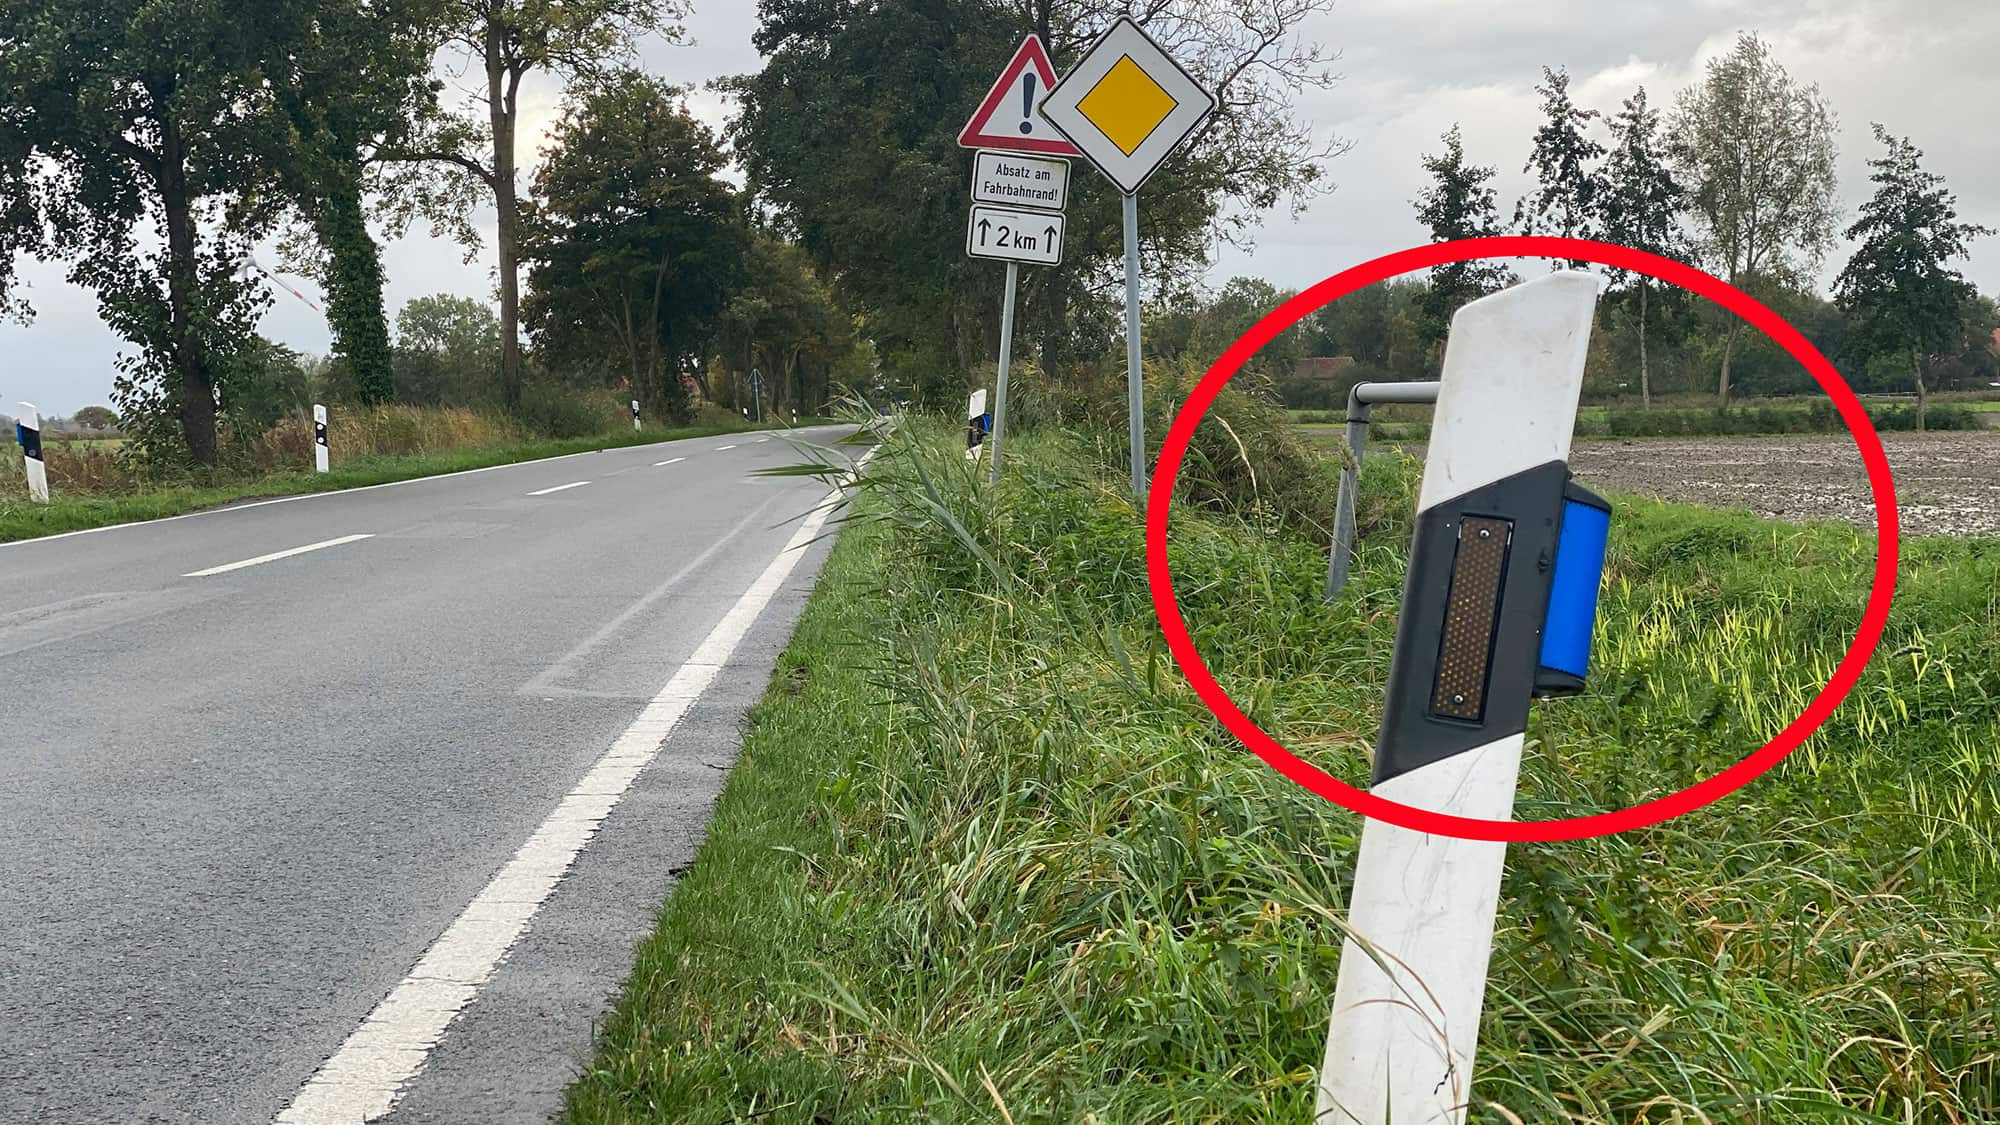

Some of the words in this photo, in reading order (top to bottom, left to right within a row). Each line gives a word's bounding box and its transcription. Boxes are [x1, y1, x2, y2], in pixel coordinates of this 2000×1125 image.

[996, 163, 1030, 179] Absatz
[1035, 170, 1051, 181] am
[983, 181, 1058, 201] Fahrbahnrand!
[996, 225, 1010, 247] 2
[1013, 230, 1037, 250] km
